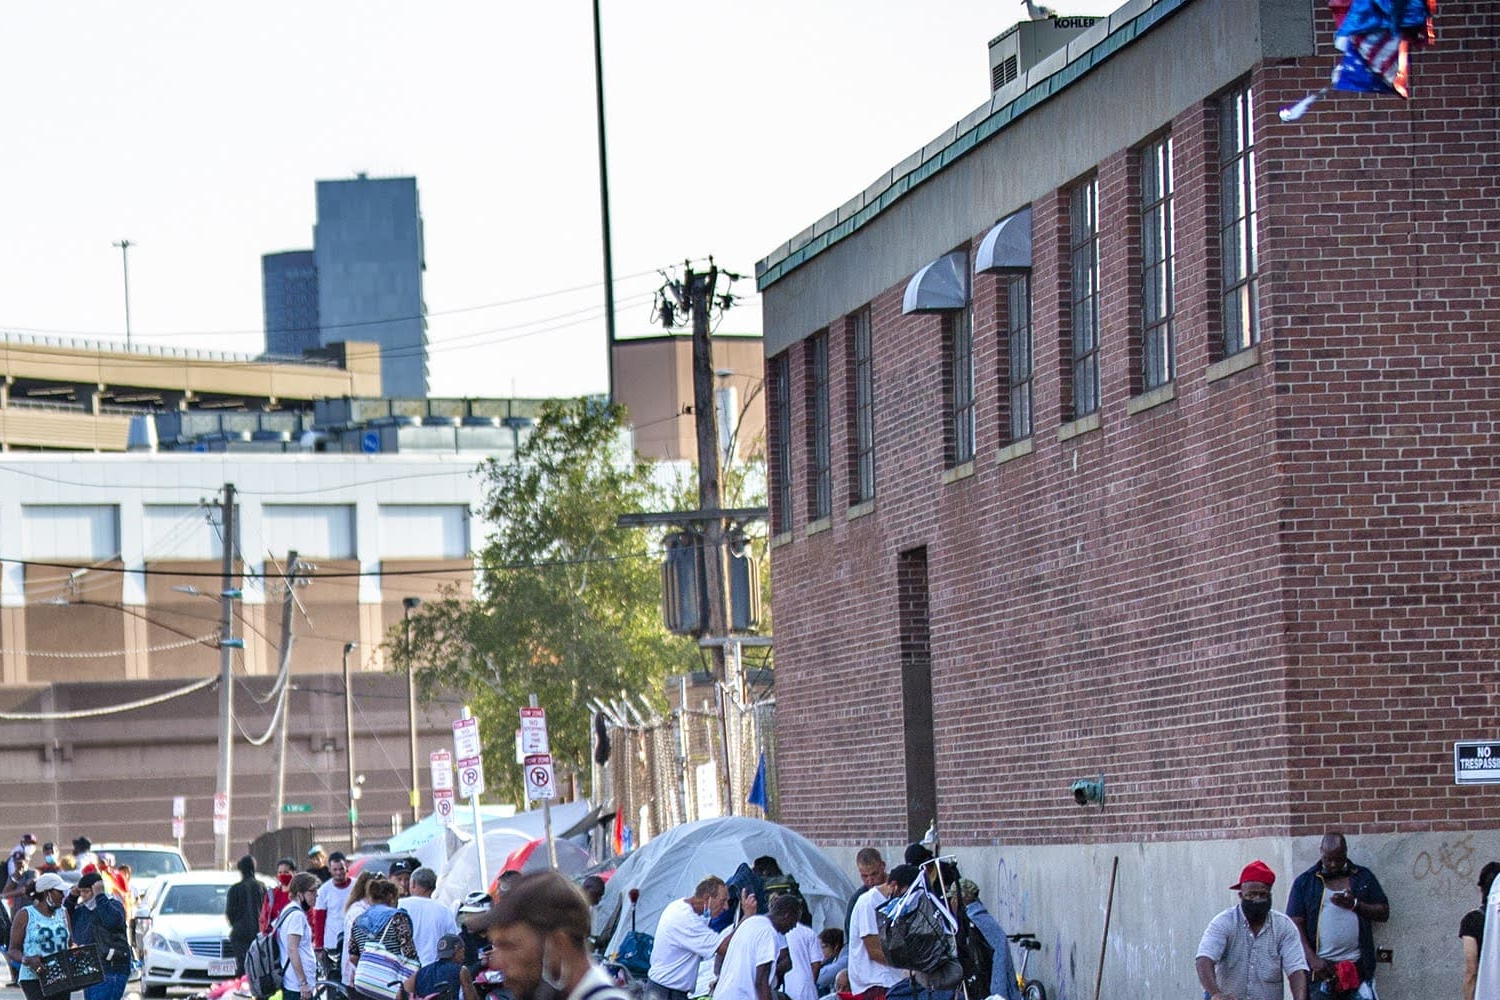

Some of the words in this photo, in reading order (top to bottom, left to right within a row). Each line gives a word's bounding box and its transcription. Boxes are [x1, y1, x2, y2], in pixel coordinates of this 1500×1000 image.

[1054, 18, 1095, 29] KOHLER
[1477, 746, 1491, 758] NO
[38, 927, 68, 953] 33
